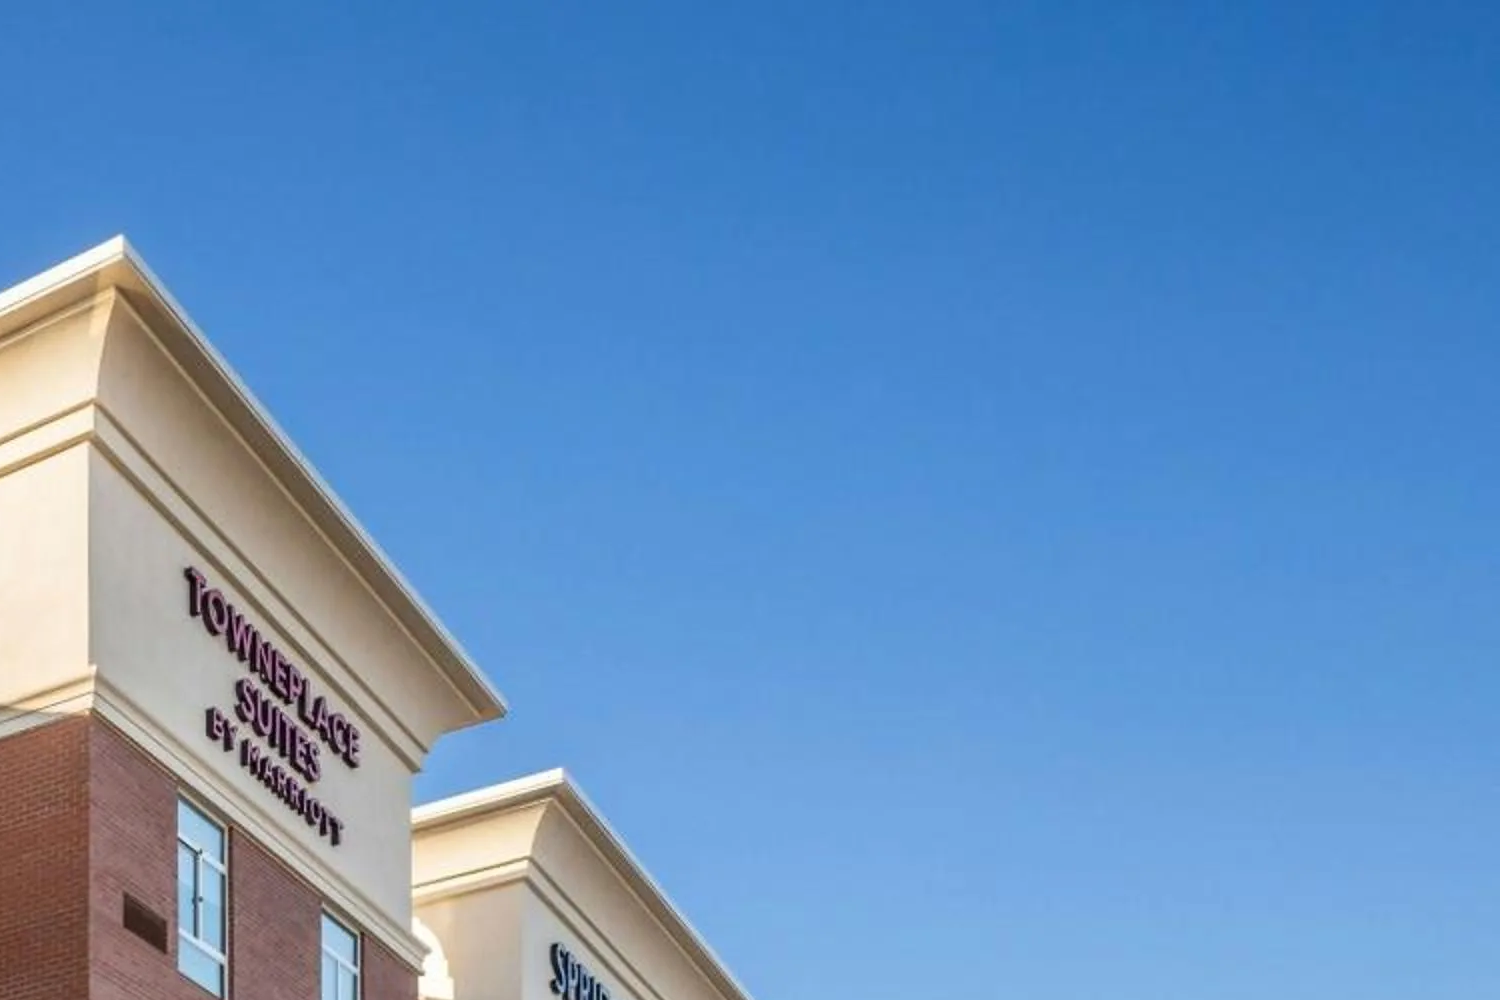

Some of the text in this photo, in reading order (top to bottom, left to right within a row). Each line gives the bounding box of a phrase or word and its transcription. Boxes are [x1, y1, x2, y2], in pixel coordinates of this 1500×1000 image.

[184, 566, 361, 768] TOWNEPLACE
[235, 678, 321, 784] SUITES
[205, 707, 344, 846] BY MARRIOTT
